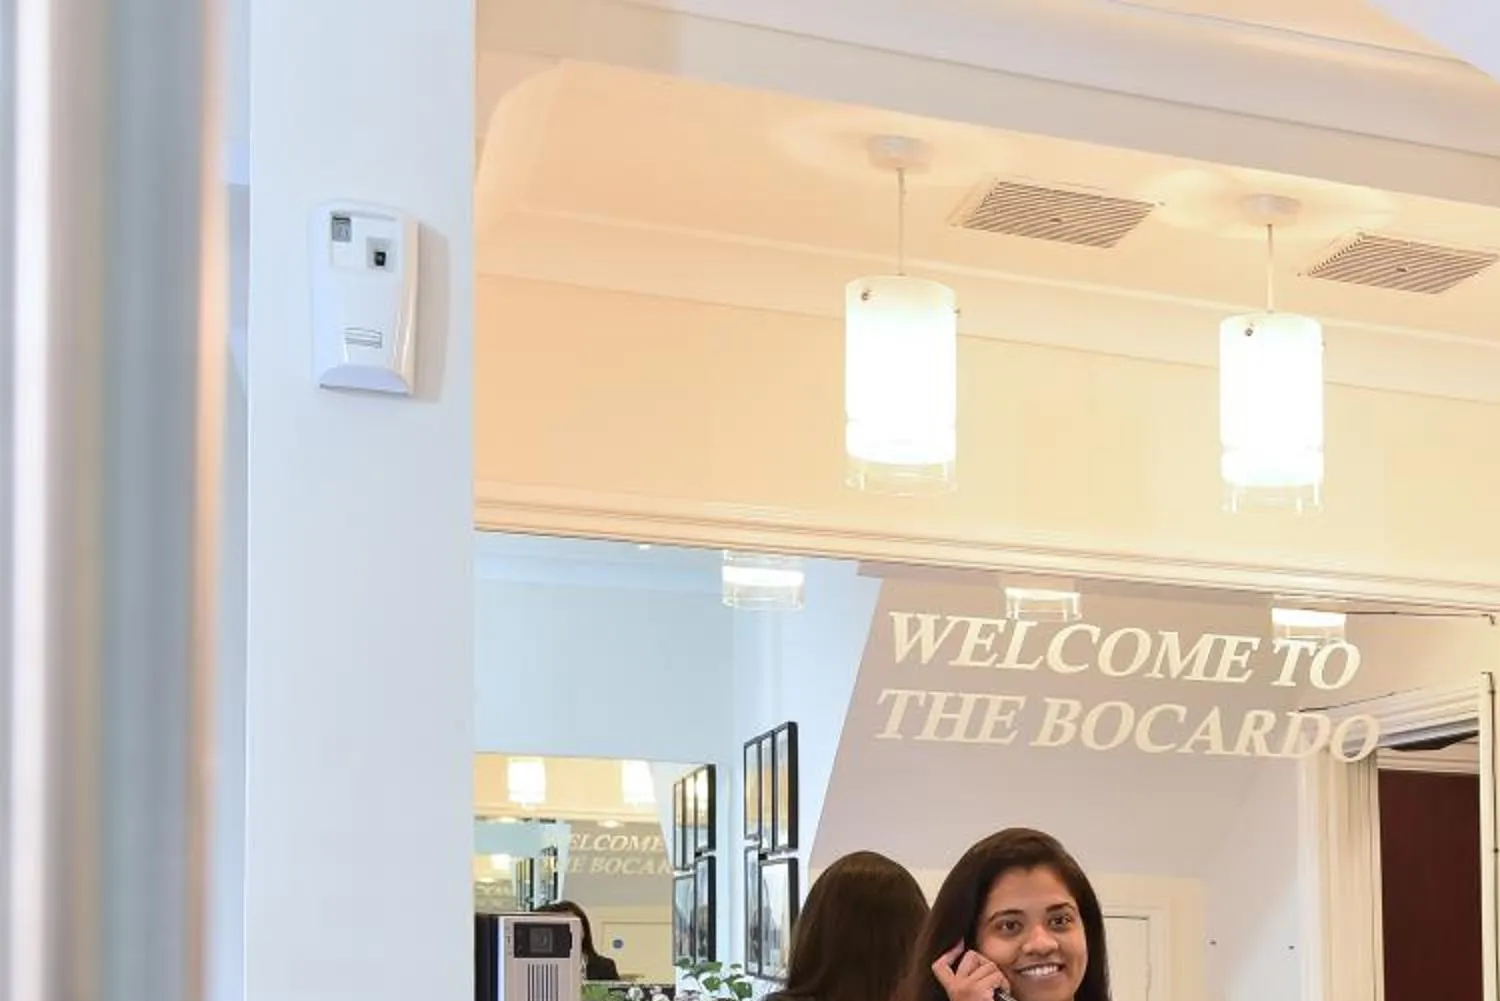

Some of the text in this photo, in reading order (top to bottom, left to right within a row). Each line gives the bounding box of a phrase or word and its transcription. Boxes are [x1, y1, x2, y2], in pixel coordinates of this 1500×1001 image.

[888, 611, 1361, 690] WELCOME TO
[875, 689, 1379, 763] THE BOCARDO
